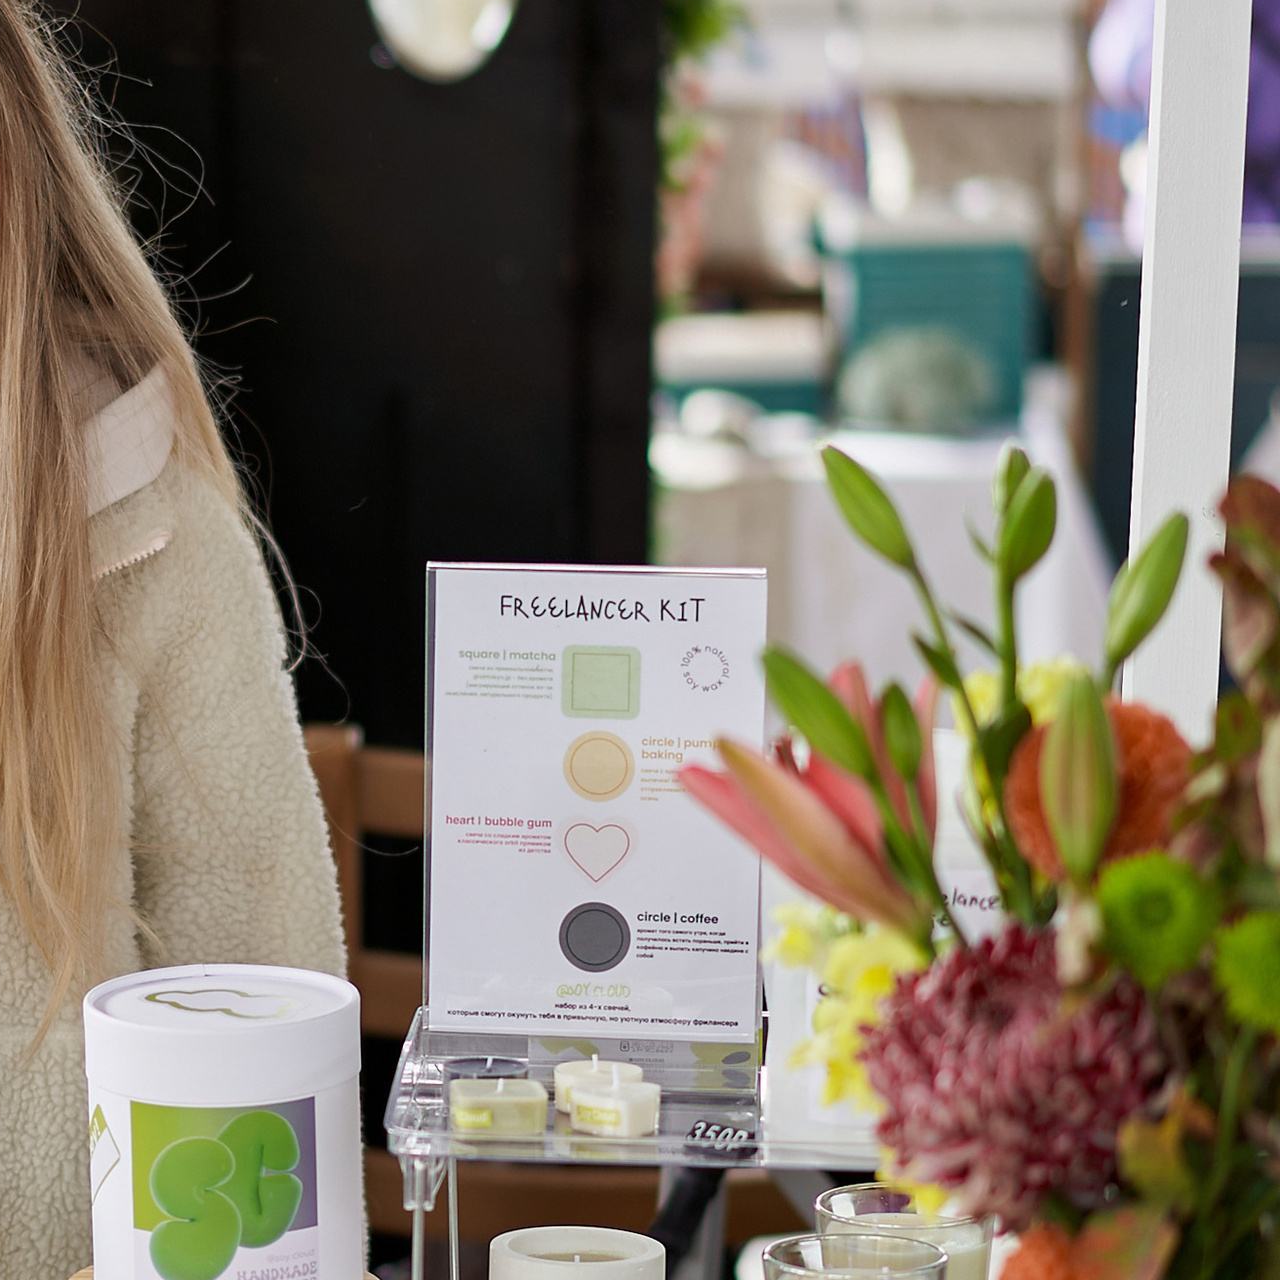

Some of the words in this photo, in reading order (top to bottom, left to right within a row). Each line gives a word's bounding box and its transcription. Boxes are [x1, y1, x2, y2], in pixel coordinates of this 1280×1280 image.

[500, 594, 651, 623] FREELANCER
[659, 597, 706, 623] KIT
[458, 650, 500, 661] square
[509, 650, 557, 661] matcha
[704, 644, 730, 680] natural
[701, 678, 725, 693] wax
[641, 736, 675, 747] circle
[683, 739, 720, 751] pump
[641, 750, 683, 764] baking
[445, 815, 475, 825] heart
[484, 816, 524, 827] bubble
[527, 819, 553, 830] gum
[637, 911, 671, 923] circle
[680, 912, 719, 924] coffee
[554, 1002, 577, 1010] набор
[603, 1004, 631, 1012] свечей,
[447, 1009, 479, 1017] которые
[480, 1010, 506, 1018] смогут
[506, 1012, 537, 1020] окунуть
[563, 1014, 608, 1023] привычную,
[619, 1016, 649, 1024] уютную
[650, 1017, 692, 1026] атмосферу
[692, 1018, 739, 1027] фрилансера
